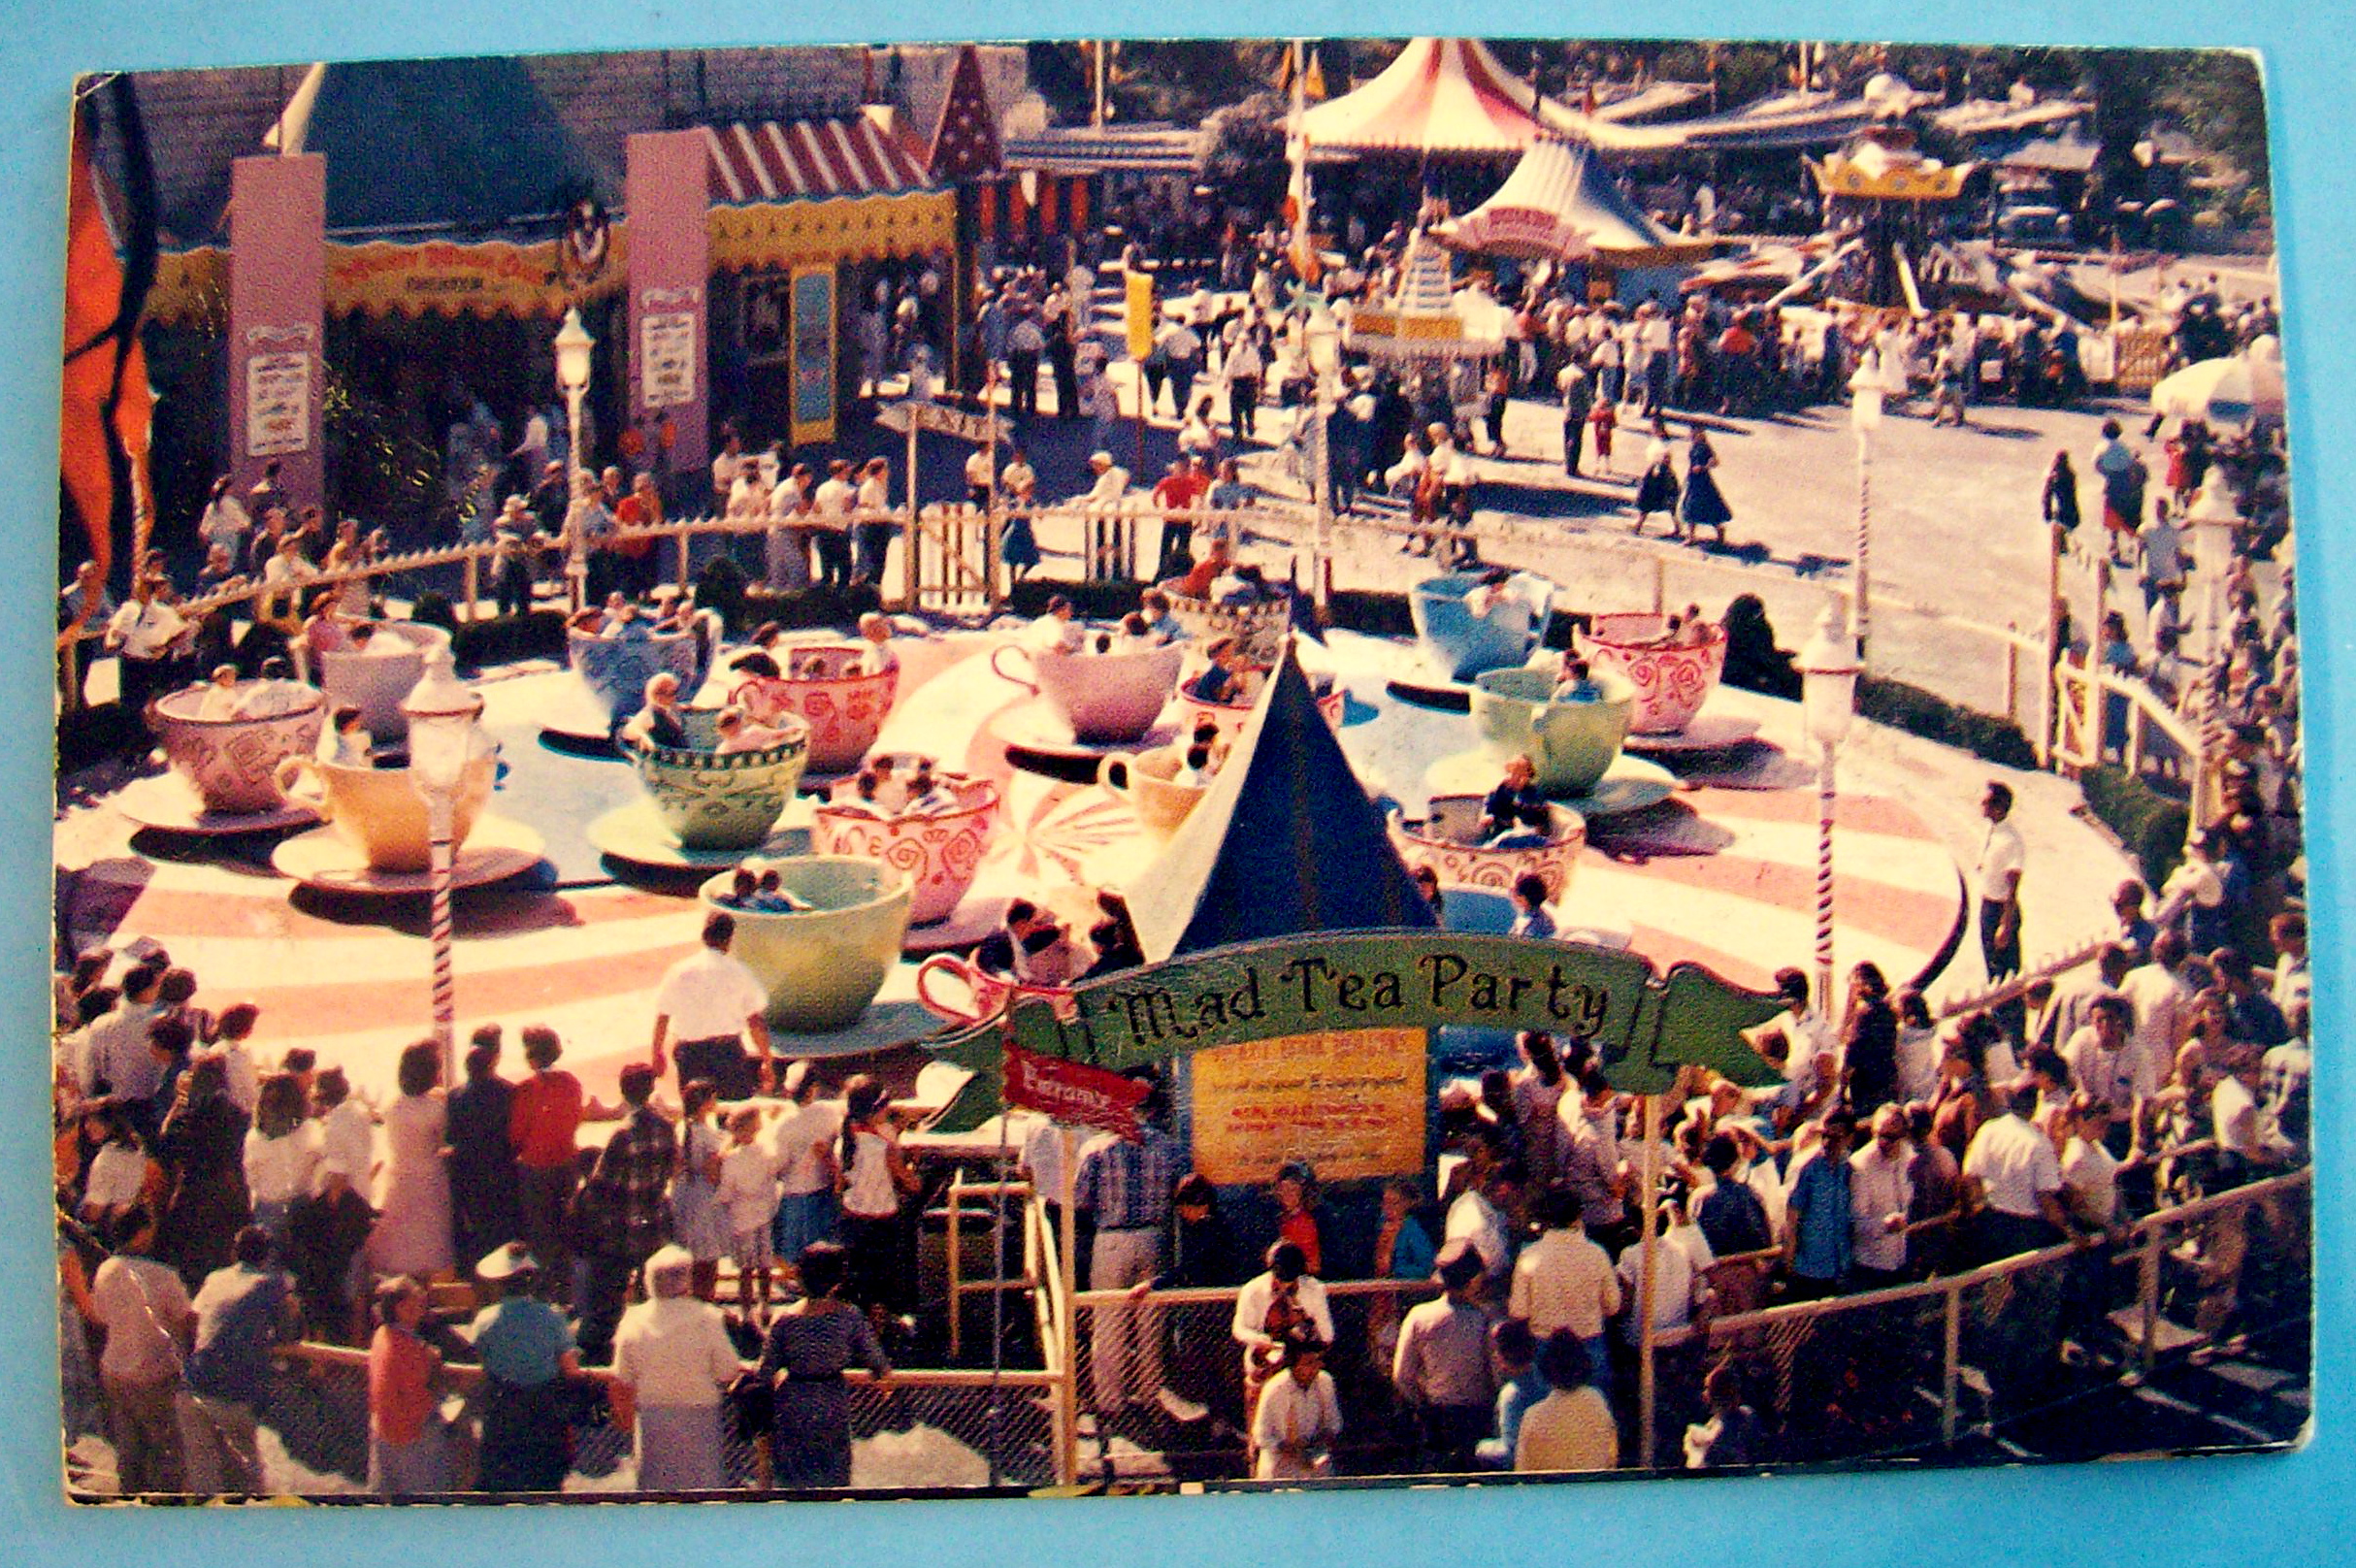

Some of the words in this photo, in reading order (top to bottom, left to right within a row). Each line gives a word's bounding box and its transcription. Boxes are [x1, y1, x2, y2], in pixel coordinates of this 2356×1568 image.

[1107, 967, 1265, 1045] Mad
[1280, 957, 1407, 1012] Tea
[1420, 955, 1607, 1038] Party
